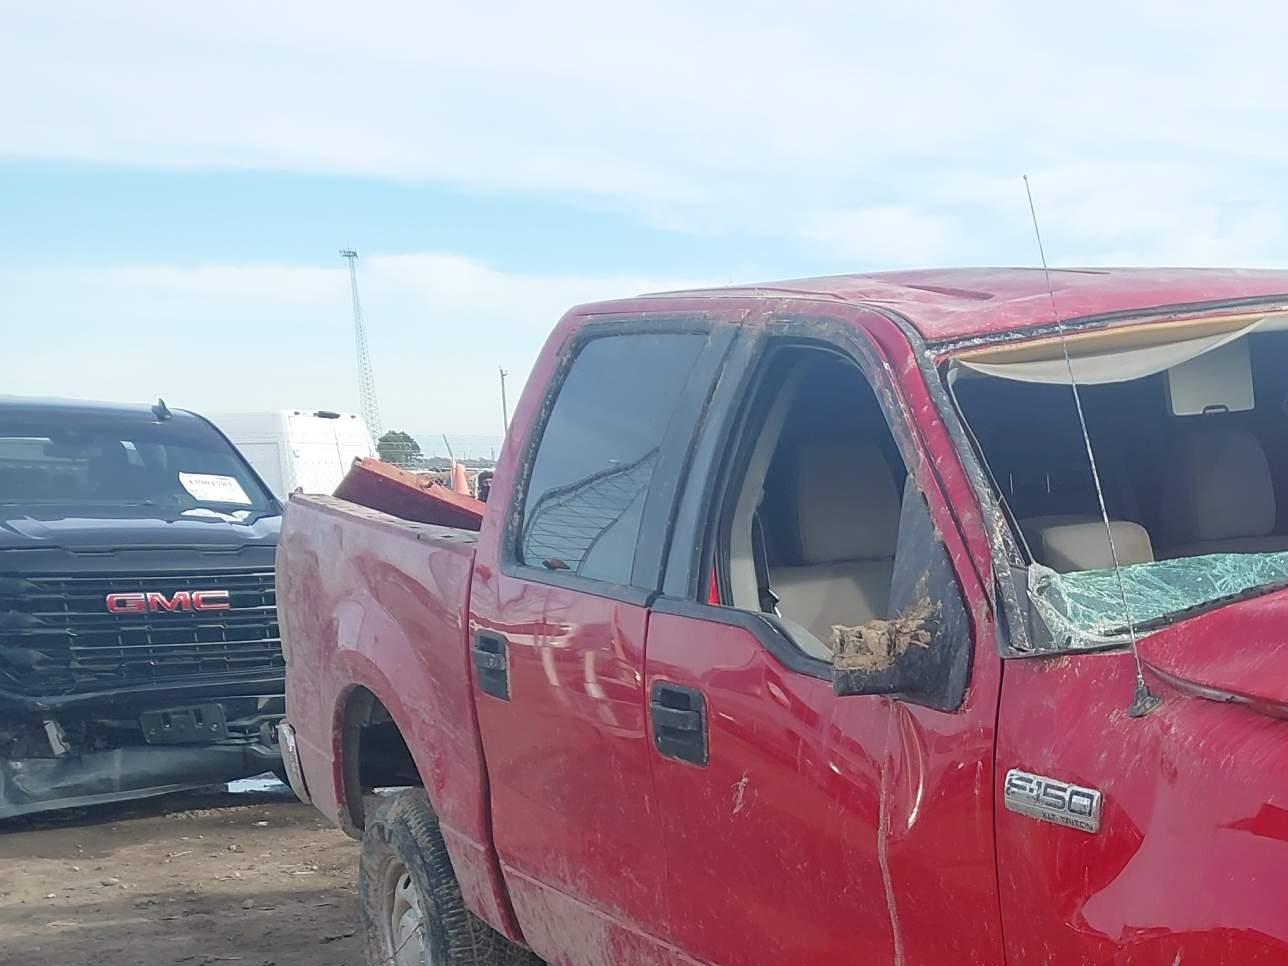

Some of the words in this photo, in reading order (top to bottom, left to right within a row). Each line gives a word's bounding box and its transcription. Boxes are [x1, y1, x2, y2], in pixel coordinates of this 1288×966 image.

[106, 590, 230, 613] GMC
[1007, 772, 1095, 817] F-150
[1041, 810, 1057, 822] XLT
[1060, 816, 1094, 831] TRITON
